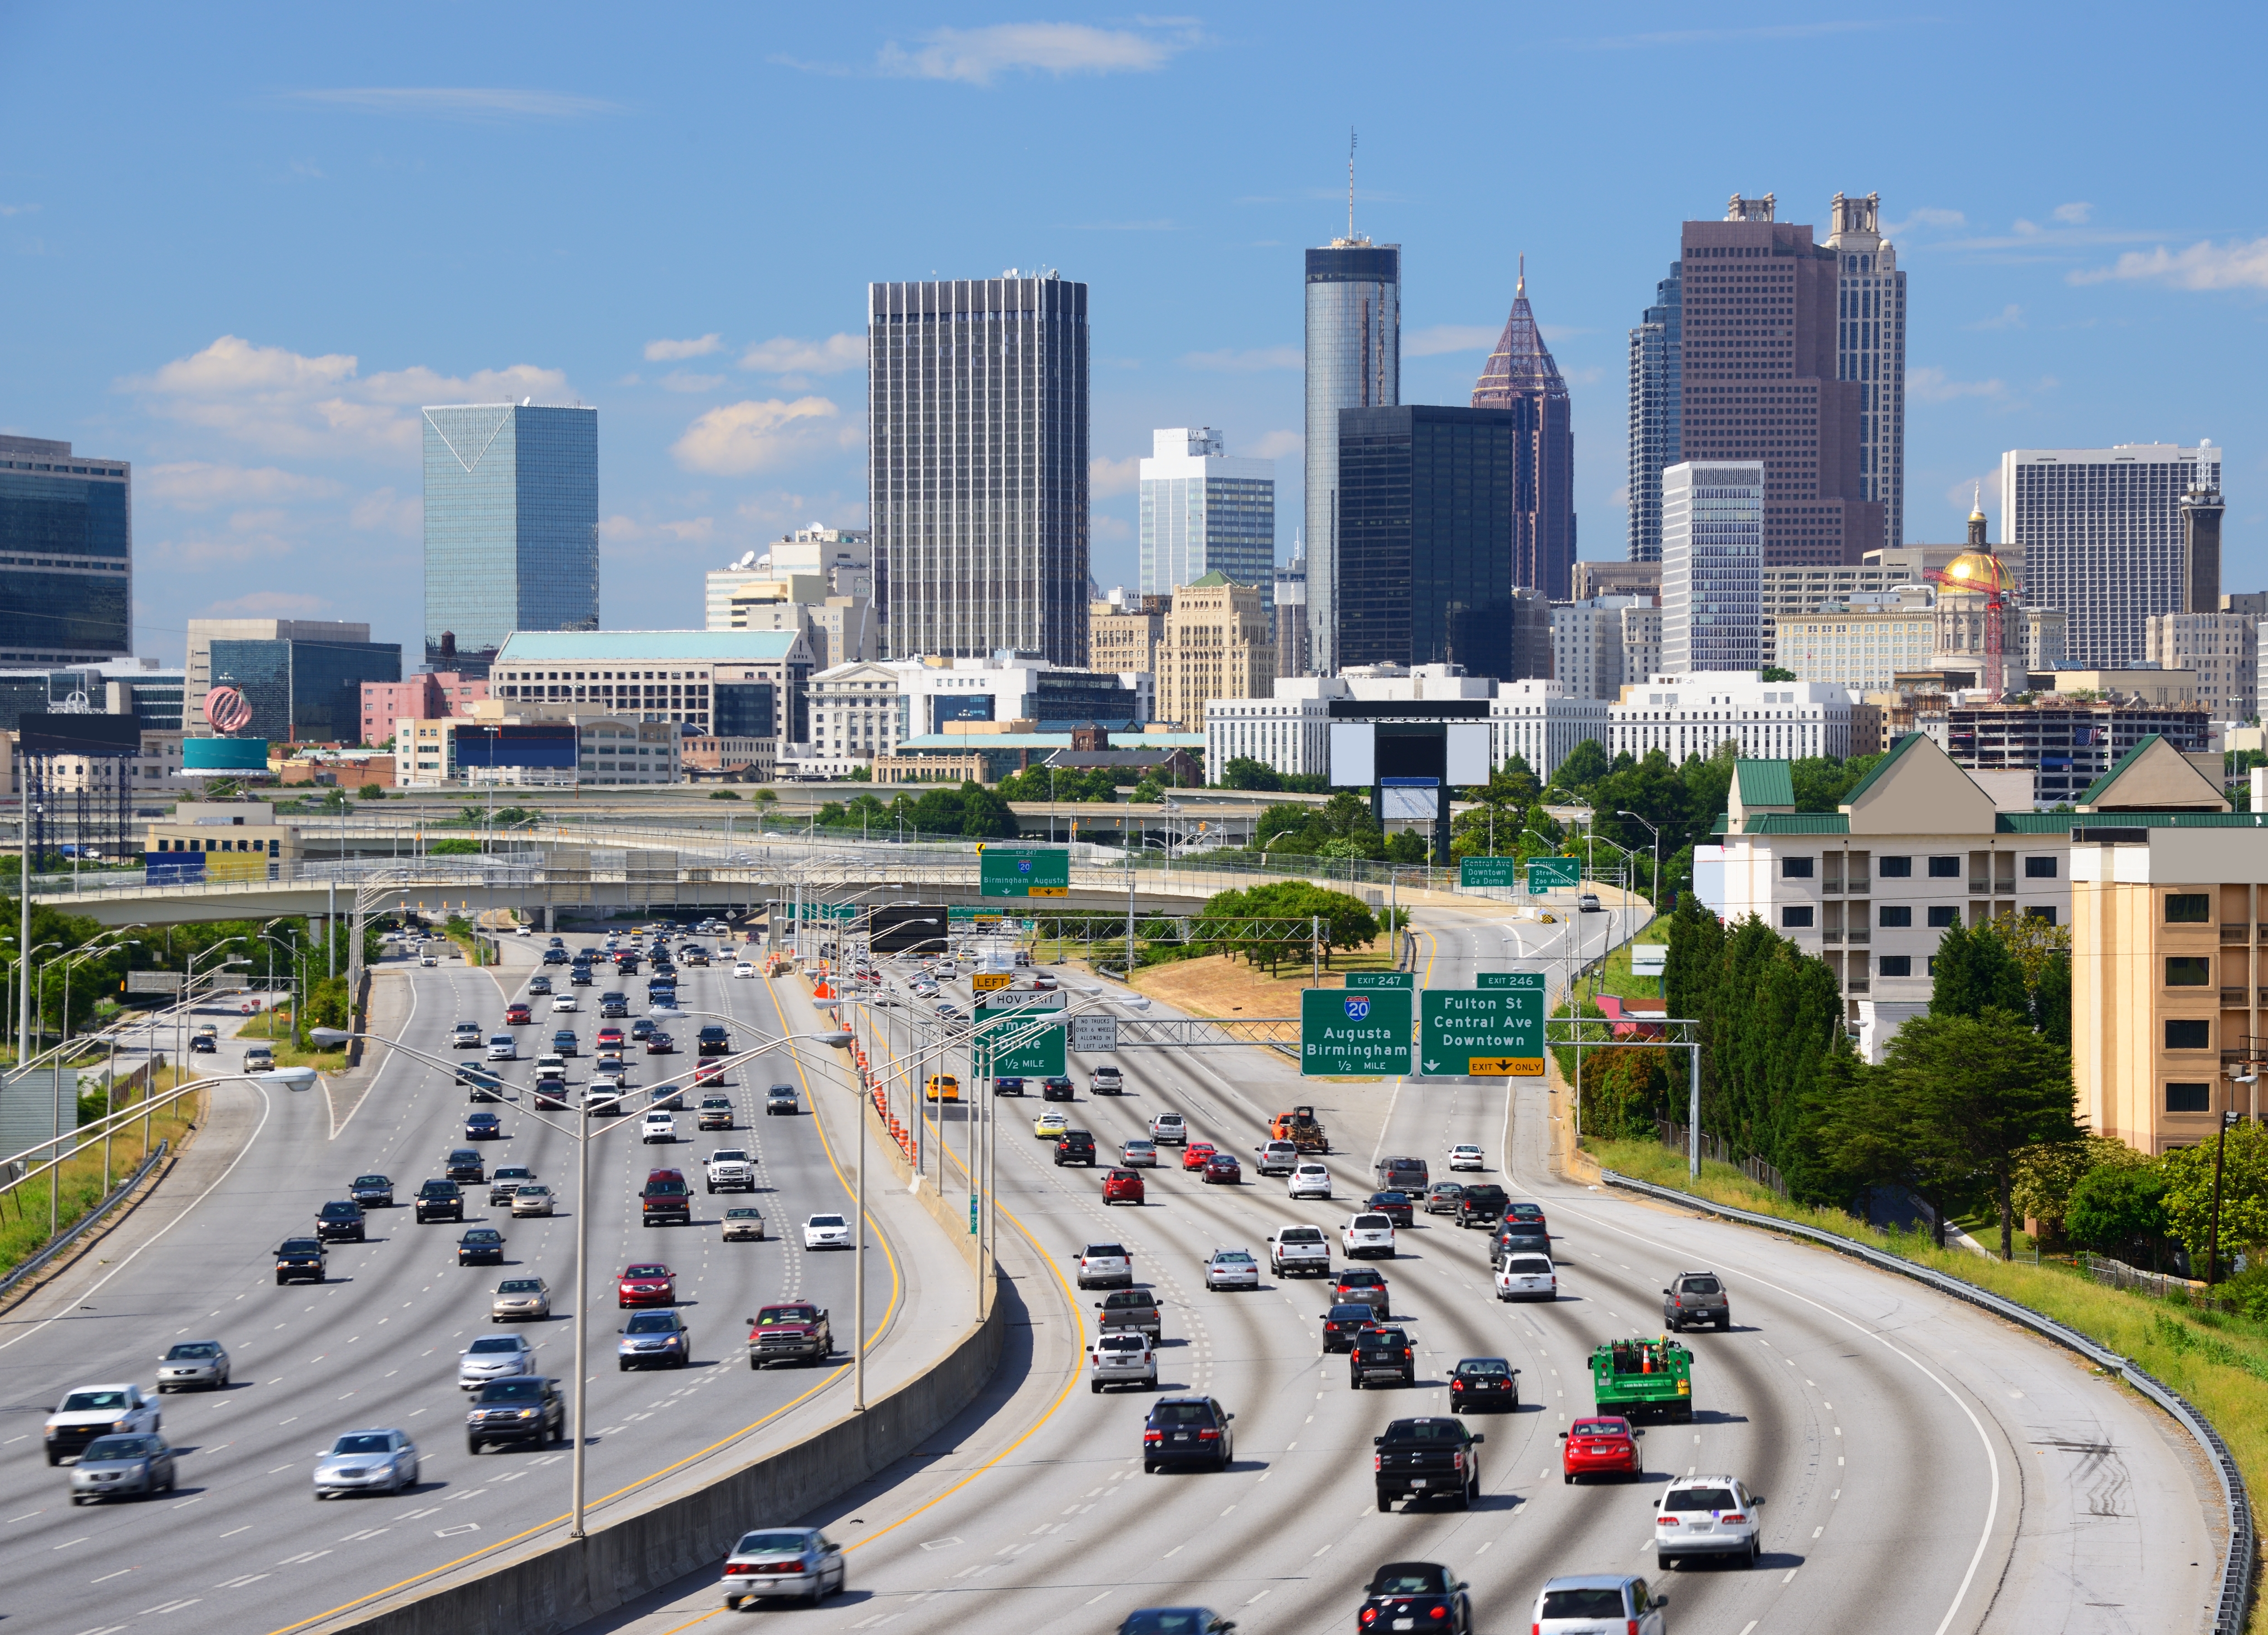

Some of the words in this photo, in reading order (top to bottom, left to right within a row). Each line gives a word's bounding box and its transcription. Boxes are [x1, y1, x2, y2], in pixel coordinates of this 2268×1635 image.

[984, 877, 1029, 885] Birmingham
[1034, 877, 1064, 886] Augusta
[978, 978, 1006, 987] LEFT
[1378, 976, 1401, 986] 247
[1509, 977, 1533, 986] 246
[997, 996, 1022, 1004] HOV
[1029, 995, 1054, 1004] EXIT
[1445, 998, 1496, 1009] Fulton
[1505, 997, 1522, 1009] St
[1349, 1002, 1368, 1016] 20
[1434, 1016, 1494, 1028] Central
[1503, 1016, 1532, 1028] Ave
[1323, 1027, 1391, 1042] Augusta
[1443, 1034, 1524, 1046] Downtown
[1307, 1044, 1407, 1059] Birmingham
